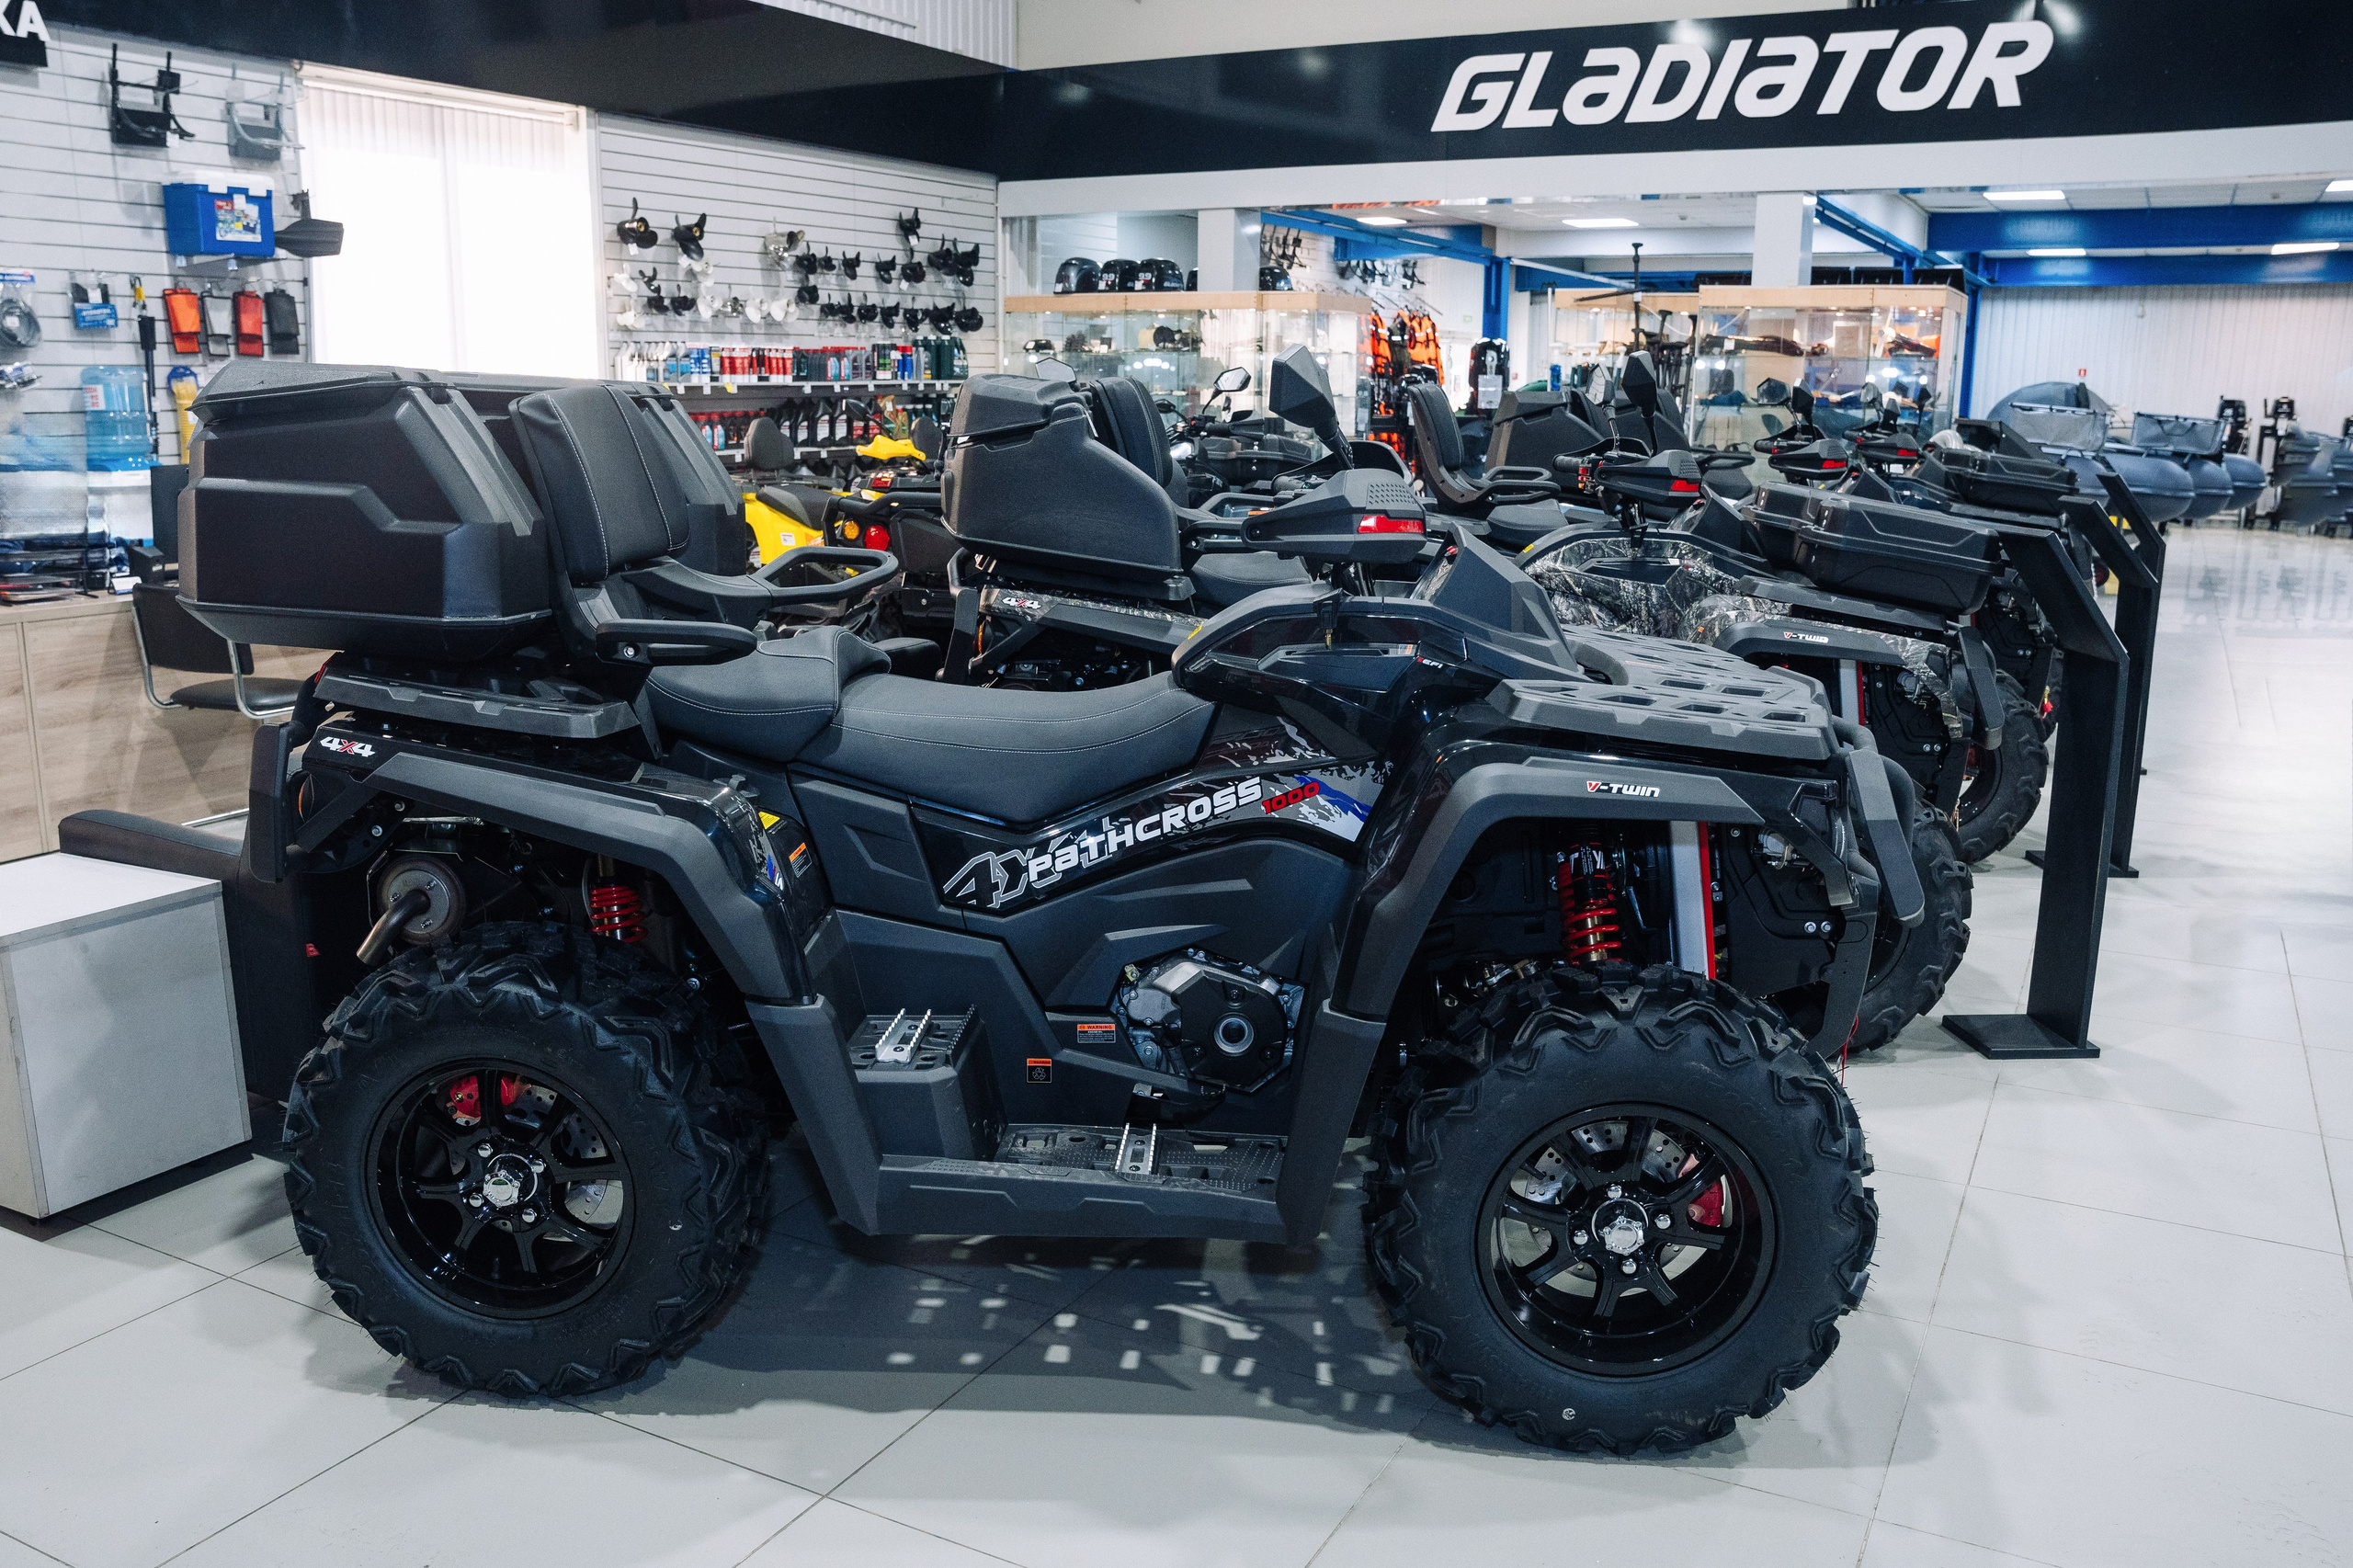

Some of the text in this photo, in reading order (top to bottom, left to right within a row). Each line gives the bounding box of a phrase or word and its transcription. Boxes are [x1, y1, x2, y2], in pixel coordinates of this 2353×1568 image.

[1430, 20, 2054, 132] GLADIATOR
[1783, 631, 1829, 644] V-TWIN
[320, 736, 376, 758] 4X4
[1586, 780, 1661, 798] V-TWIN
[1027, 776, 1321, 883] PATHCROSS 1000
